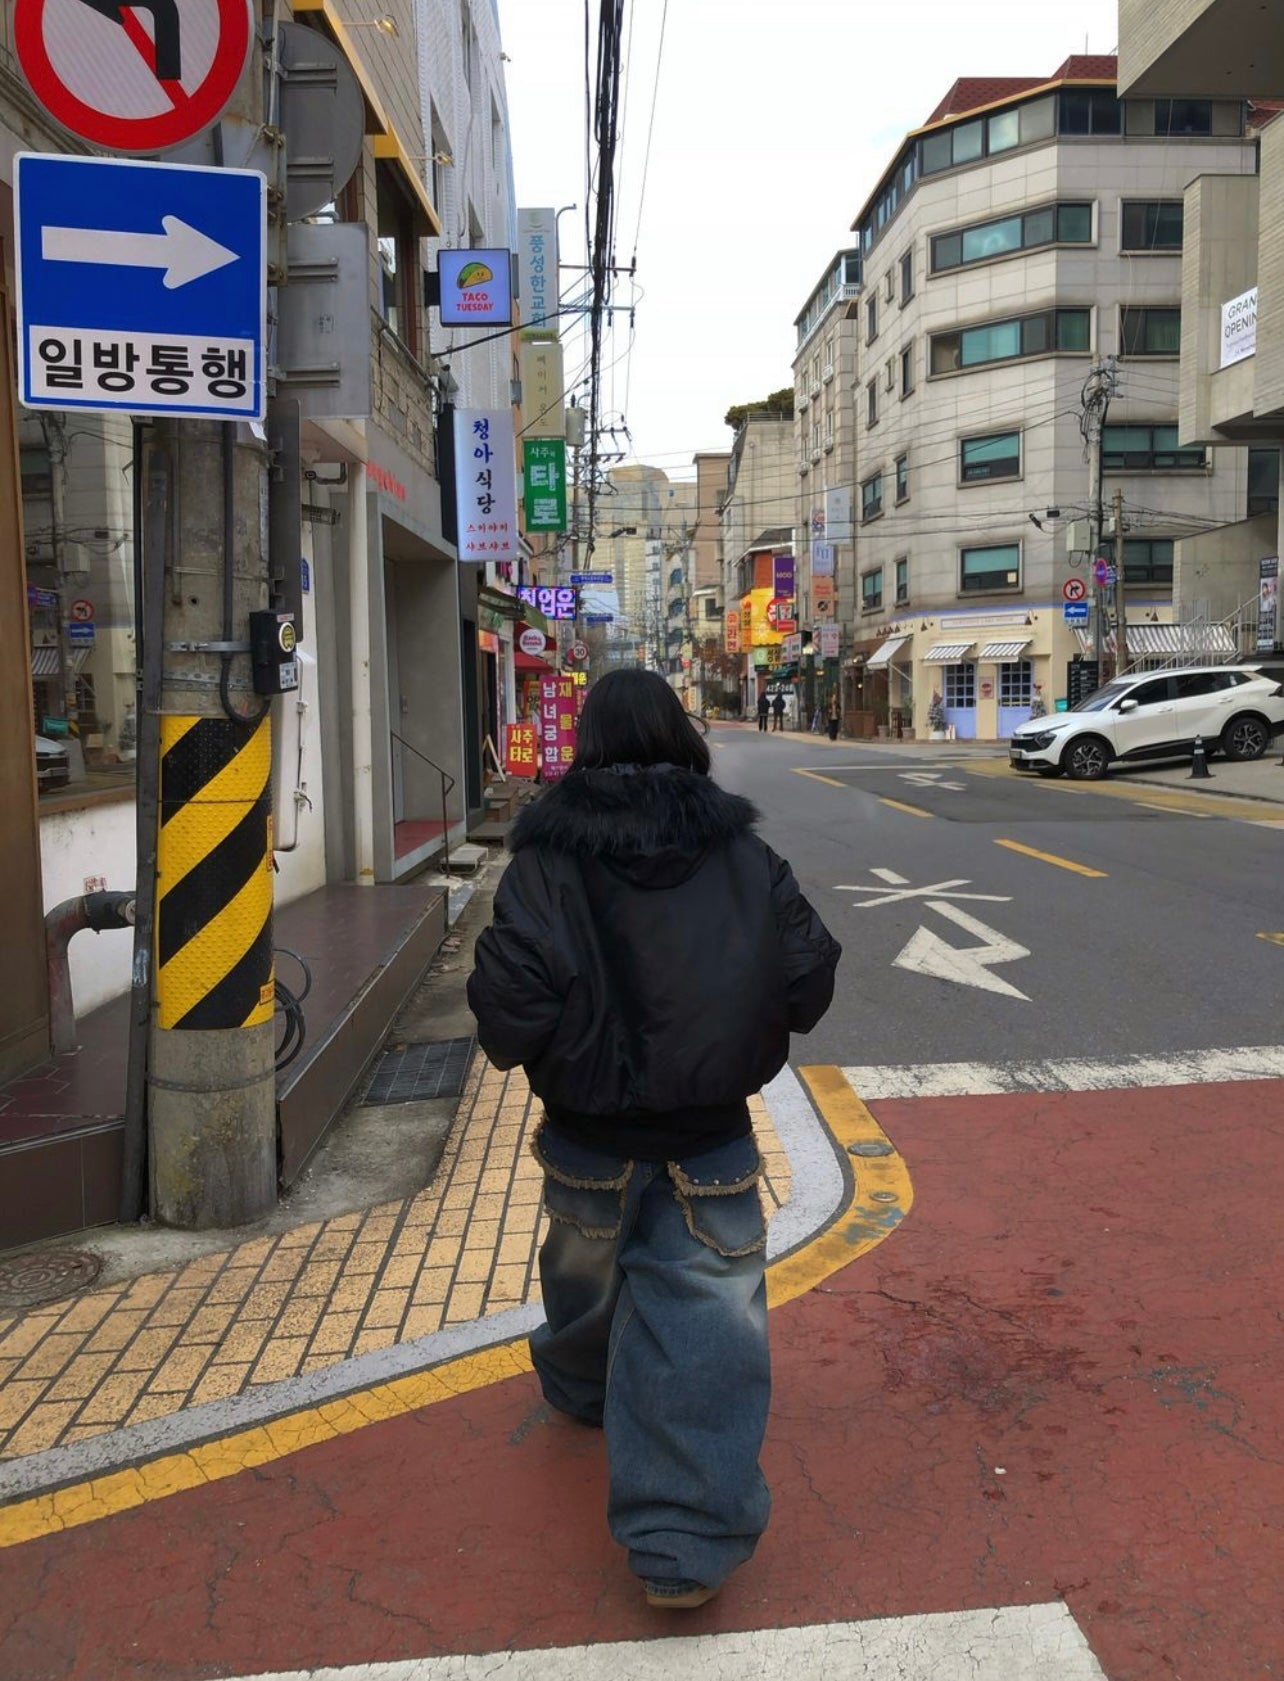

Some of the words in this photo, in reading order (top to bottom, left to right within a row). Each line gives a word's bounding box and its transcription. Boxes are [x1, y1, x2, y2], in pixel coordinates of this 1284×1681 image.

[456, 303, 494, 311] TUESDAY
[462, 292, 489, 302] TACO
[529, 234, 547, 328] 풍성한교회
[38, 338, 247, 399] 일방통행
[473, 418, 496, 515] 청아식당
[530, 463, 561, 525] 타로
[511, 729, 534, 744] 사주
[543, 681, 558, 763] 남녀궁합
[510, 746, 534, 763] 타로
